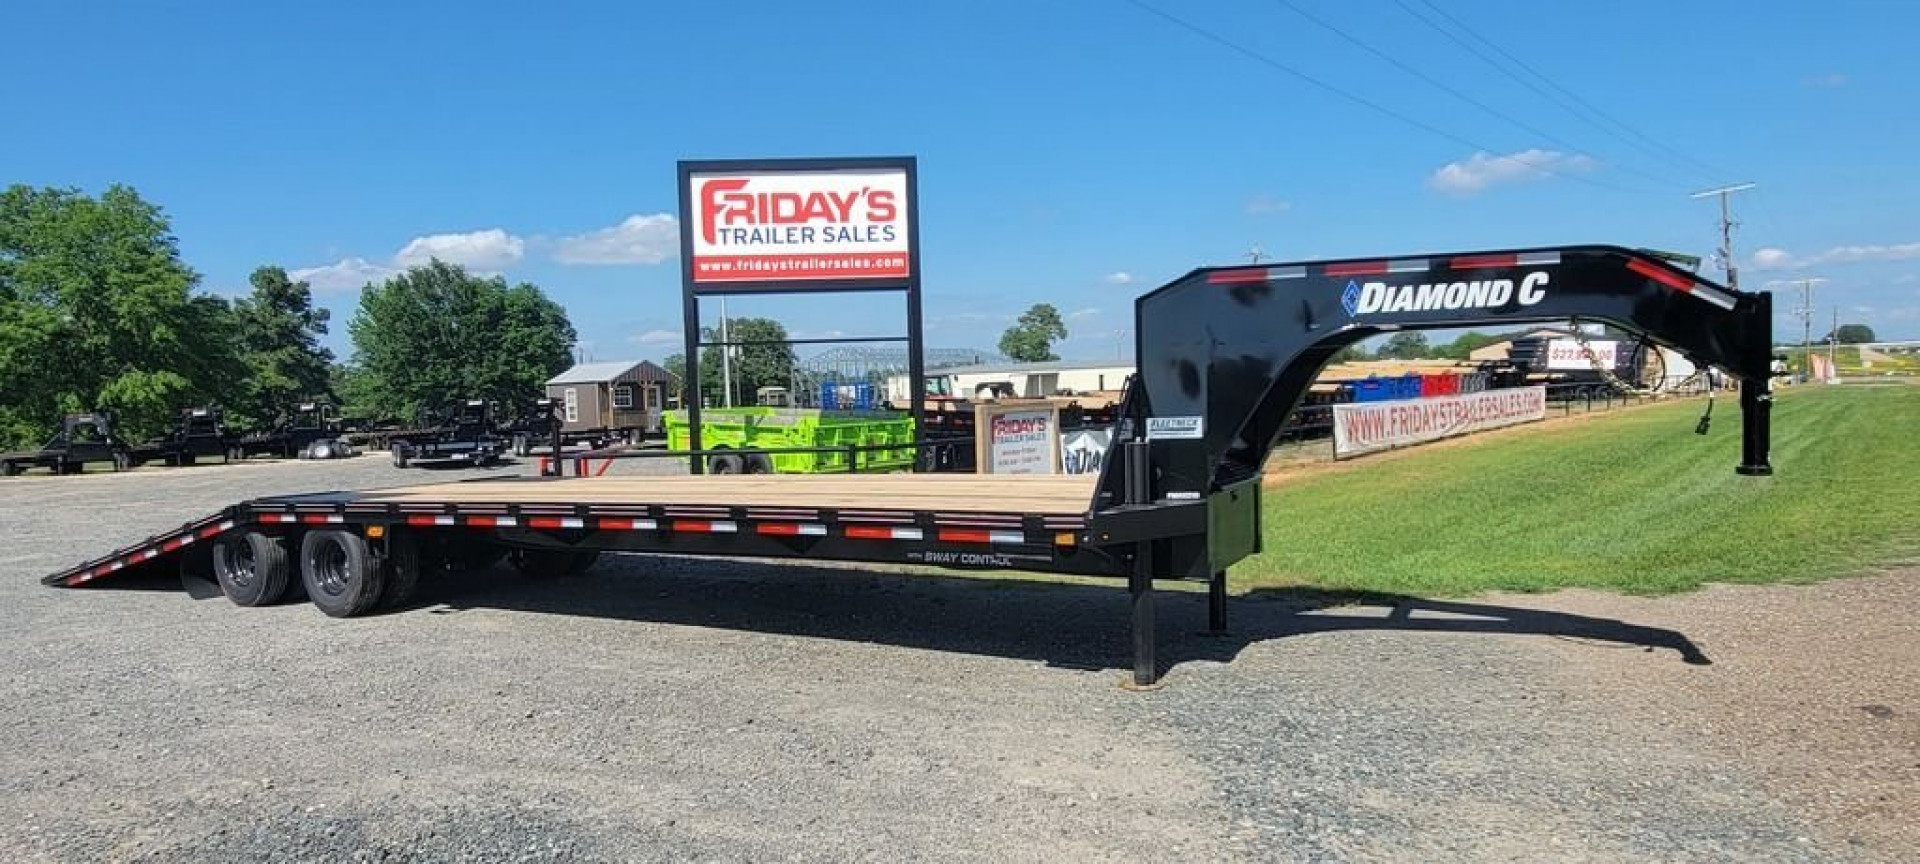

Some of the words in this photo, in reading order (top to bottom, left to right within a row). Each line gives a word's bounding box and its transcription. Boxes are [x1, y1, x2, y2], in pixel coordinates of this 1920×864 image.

[701, 179, 897, 245] FRIDAY'S
[718, 226, 815, 244] TRAILER
[823, 225, 895, 242] SALES
[700, 257, 905, 271] www.fridaystrailersales.com
[1357, 279, 1514, 314] DIAMOND
[1518, 271, 1550, 306] C
[990, 413, 1046, 444] FRIDAY'S
[1345, 392, 1544, 442] WWW.FRIDAYSTRAILERSALES.COM
[923, 550, 959, 563] SWAY
